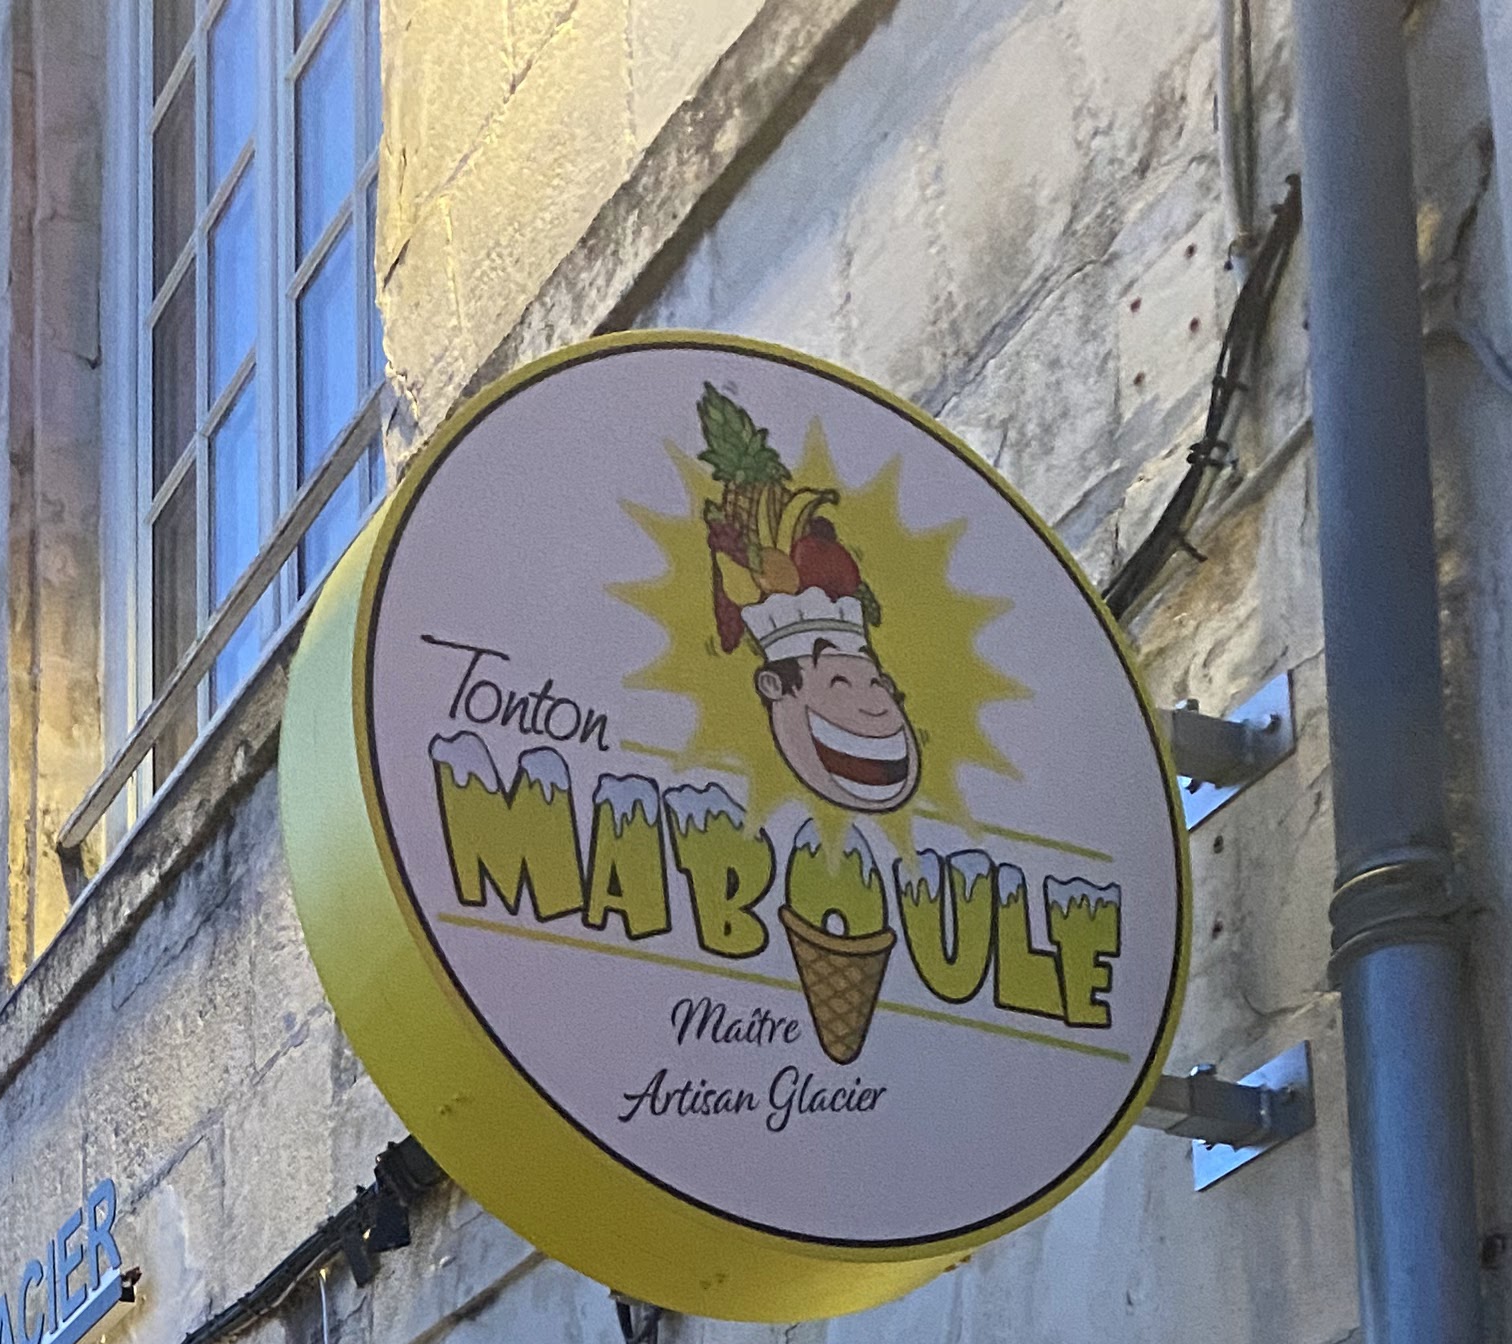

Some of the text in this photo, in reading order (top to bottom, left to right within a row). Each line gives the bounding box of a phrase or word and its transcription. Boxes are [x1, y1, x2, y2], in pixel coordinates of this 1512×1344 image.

[421, 635, 610, 752] Tonton
[428, 730, 1121, 1029] MABOULE
[671, 997, 801, 1047] Maître
[617, 1065, 887, 1133] Artisan Glacier
